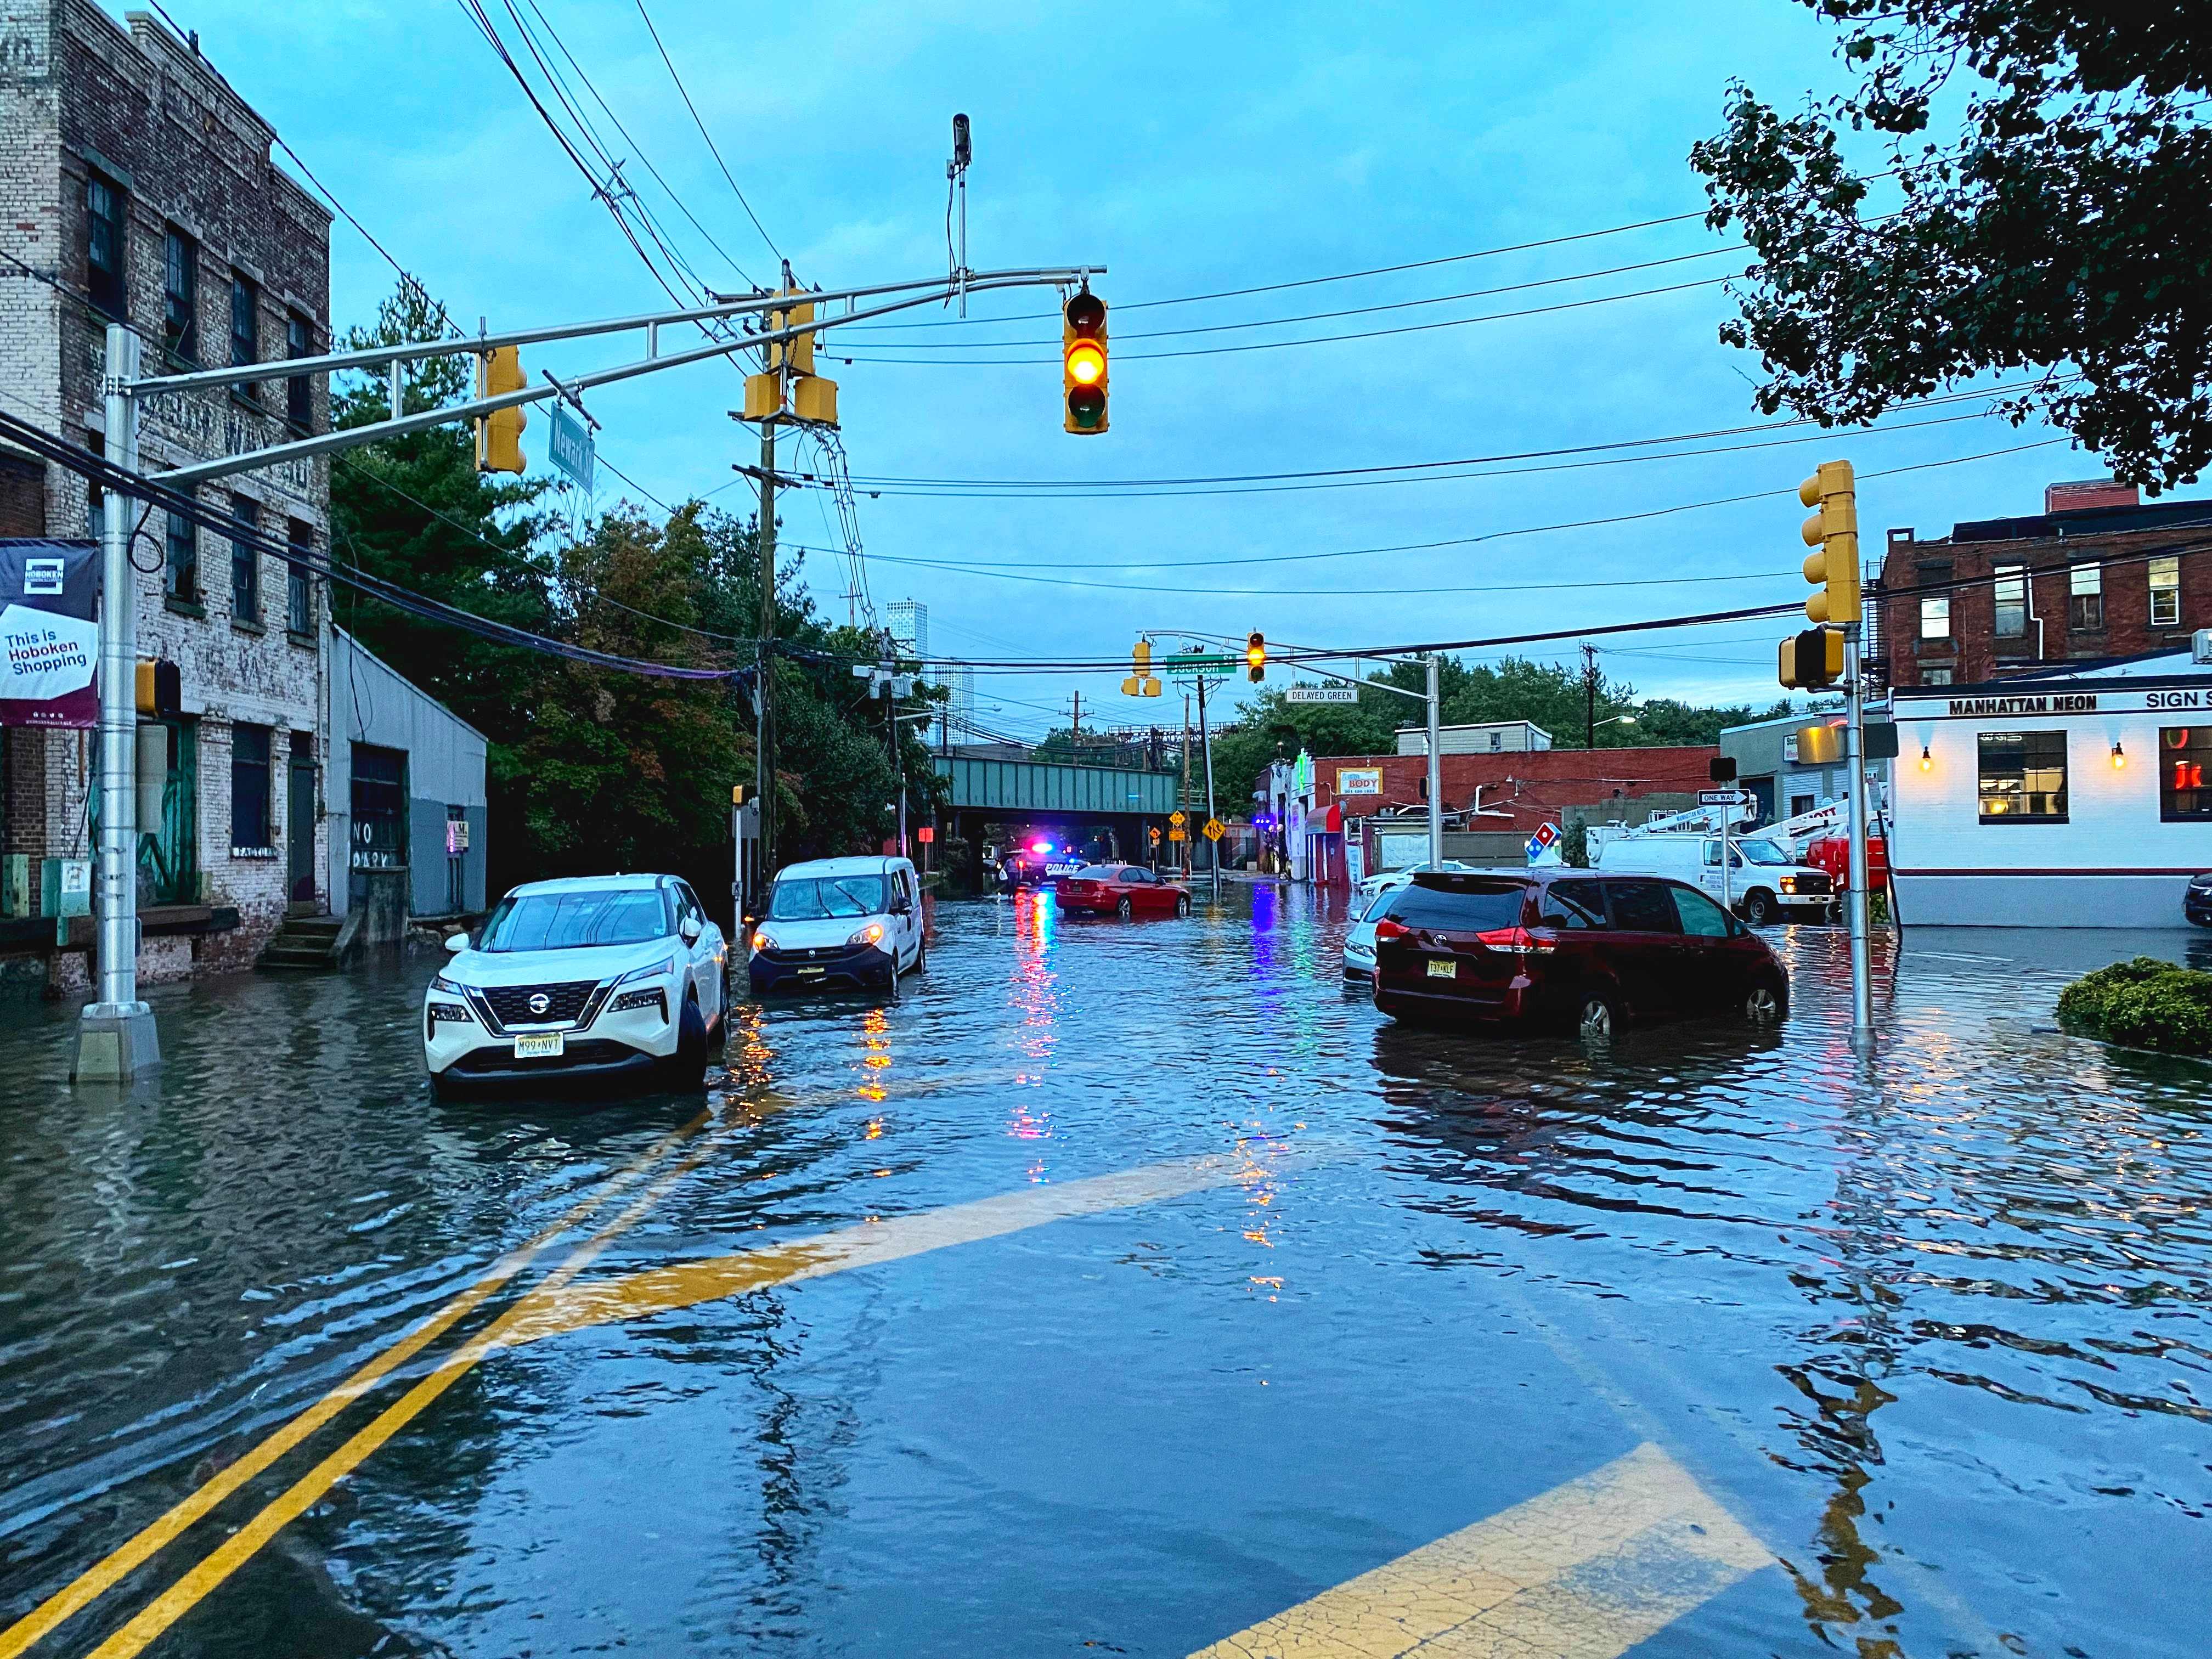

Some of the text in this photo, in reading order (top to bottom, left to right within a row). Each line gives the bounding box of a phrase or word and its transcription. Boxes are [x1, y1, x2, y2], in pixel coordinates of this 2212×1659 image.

[554, 417, 593, 482] Newark St
[5, 629, 57, 647] This is
[9, 641, 78, 662] Hoboken
[13, 653, 87, 675] Shopping
[1292, 691, 1352, 699] DELAYED GREEN
[1949, 695, 2097, 715] MANHATTAN NEON
[2146, 692, 2198, 708] SIGN
[353, 822, 371, 844] NO
[1045, 863, 1080, 874] POLICE
